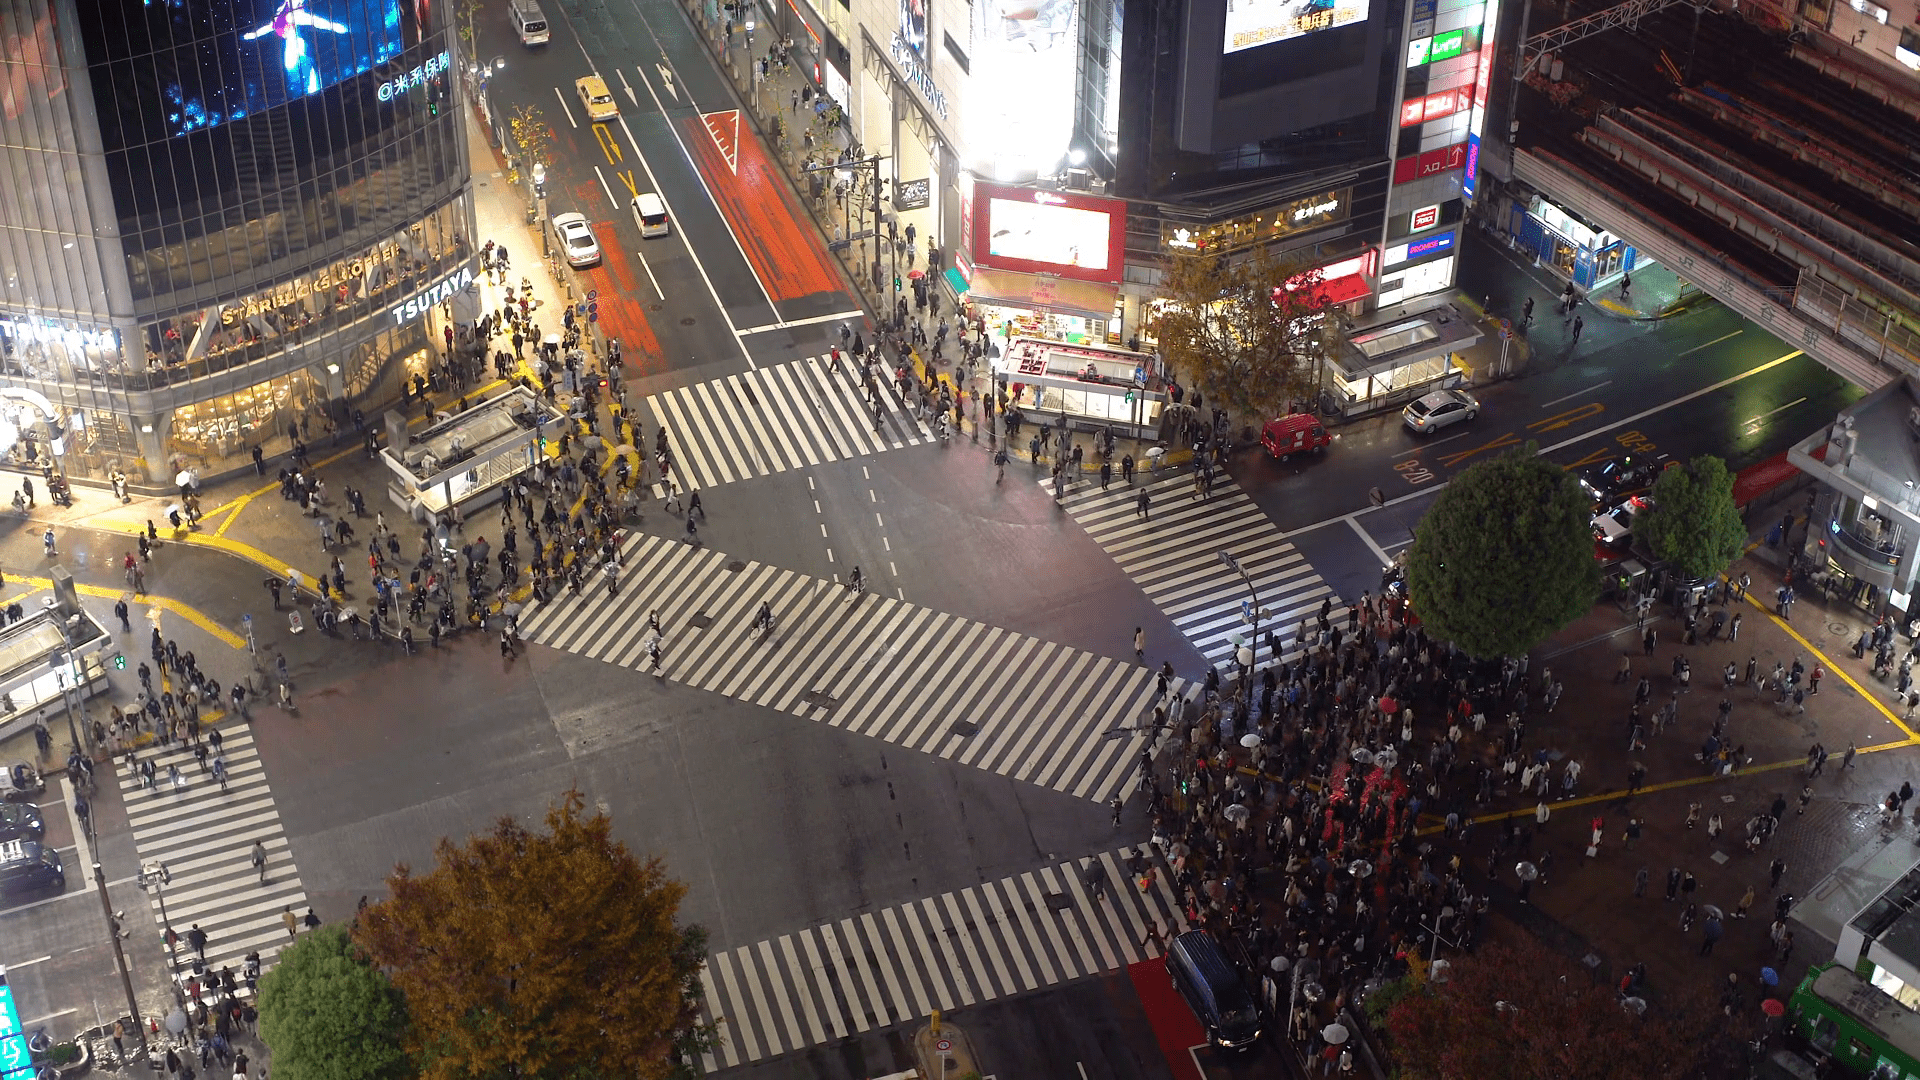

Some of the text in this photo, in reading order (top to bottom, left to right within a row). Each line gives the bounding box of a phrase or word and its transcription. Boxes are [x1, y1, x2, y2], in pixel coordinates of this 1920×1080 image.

[1417, 28, 1427, 37] 6F
[1422, 161, 1441, 174] 入口
[392, 267, 473, 325] TSUTAYA
[1393, 460, 1434, 484] 8-20
